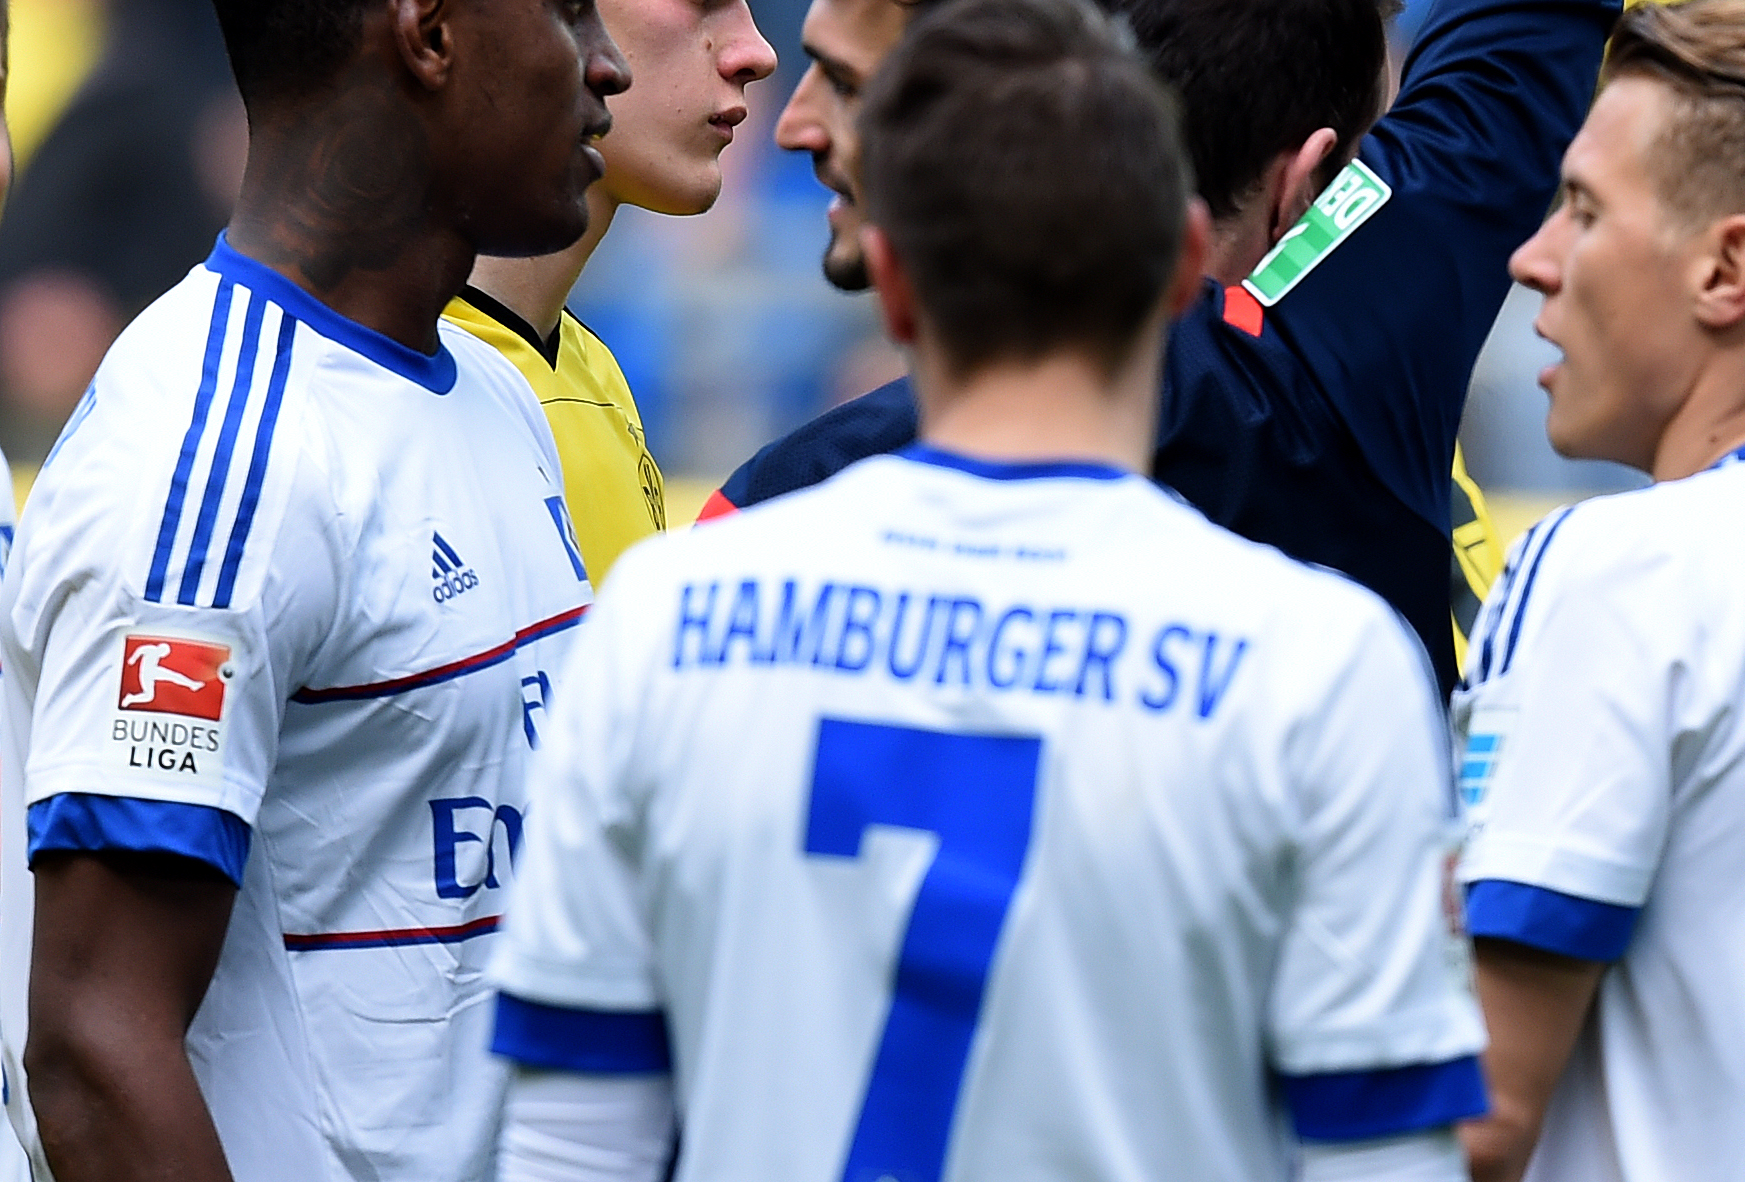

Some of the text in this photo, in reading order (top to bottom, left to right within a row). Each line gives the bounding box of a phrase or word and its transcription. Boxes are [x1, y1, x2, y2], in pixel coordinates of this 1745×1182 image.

[433, 569, 479, 604] adidas
[672, 580, 1248, 720] HAMBURGER SV
[113, 719, 219, 752] BUNDES
[129, 746, 197, 774] LIGA
[802, 717, 1044, 1182] 7
